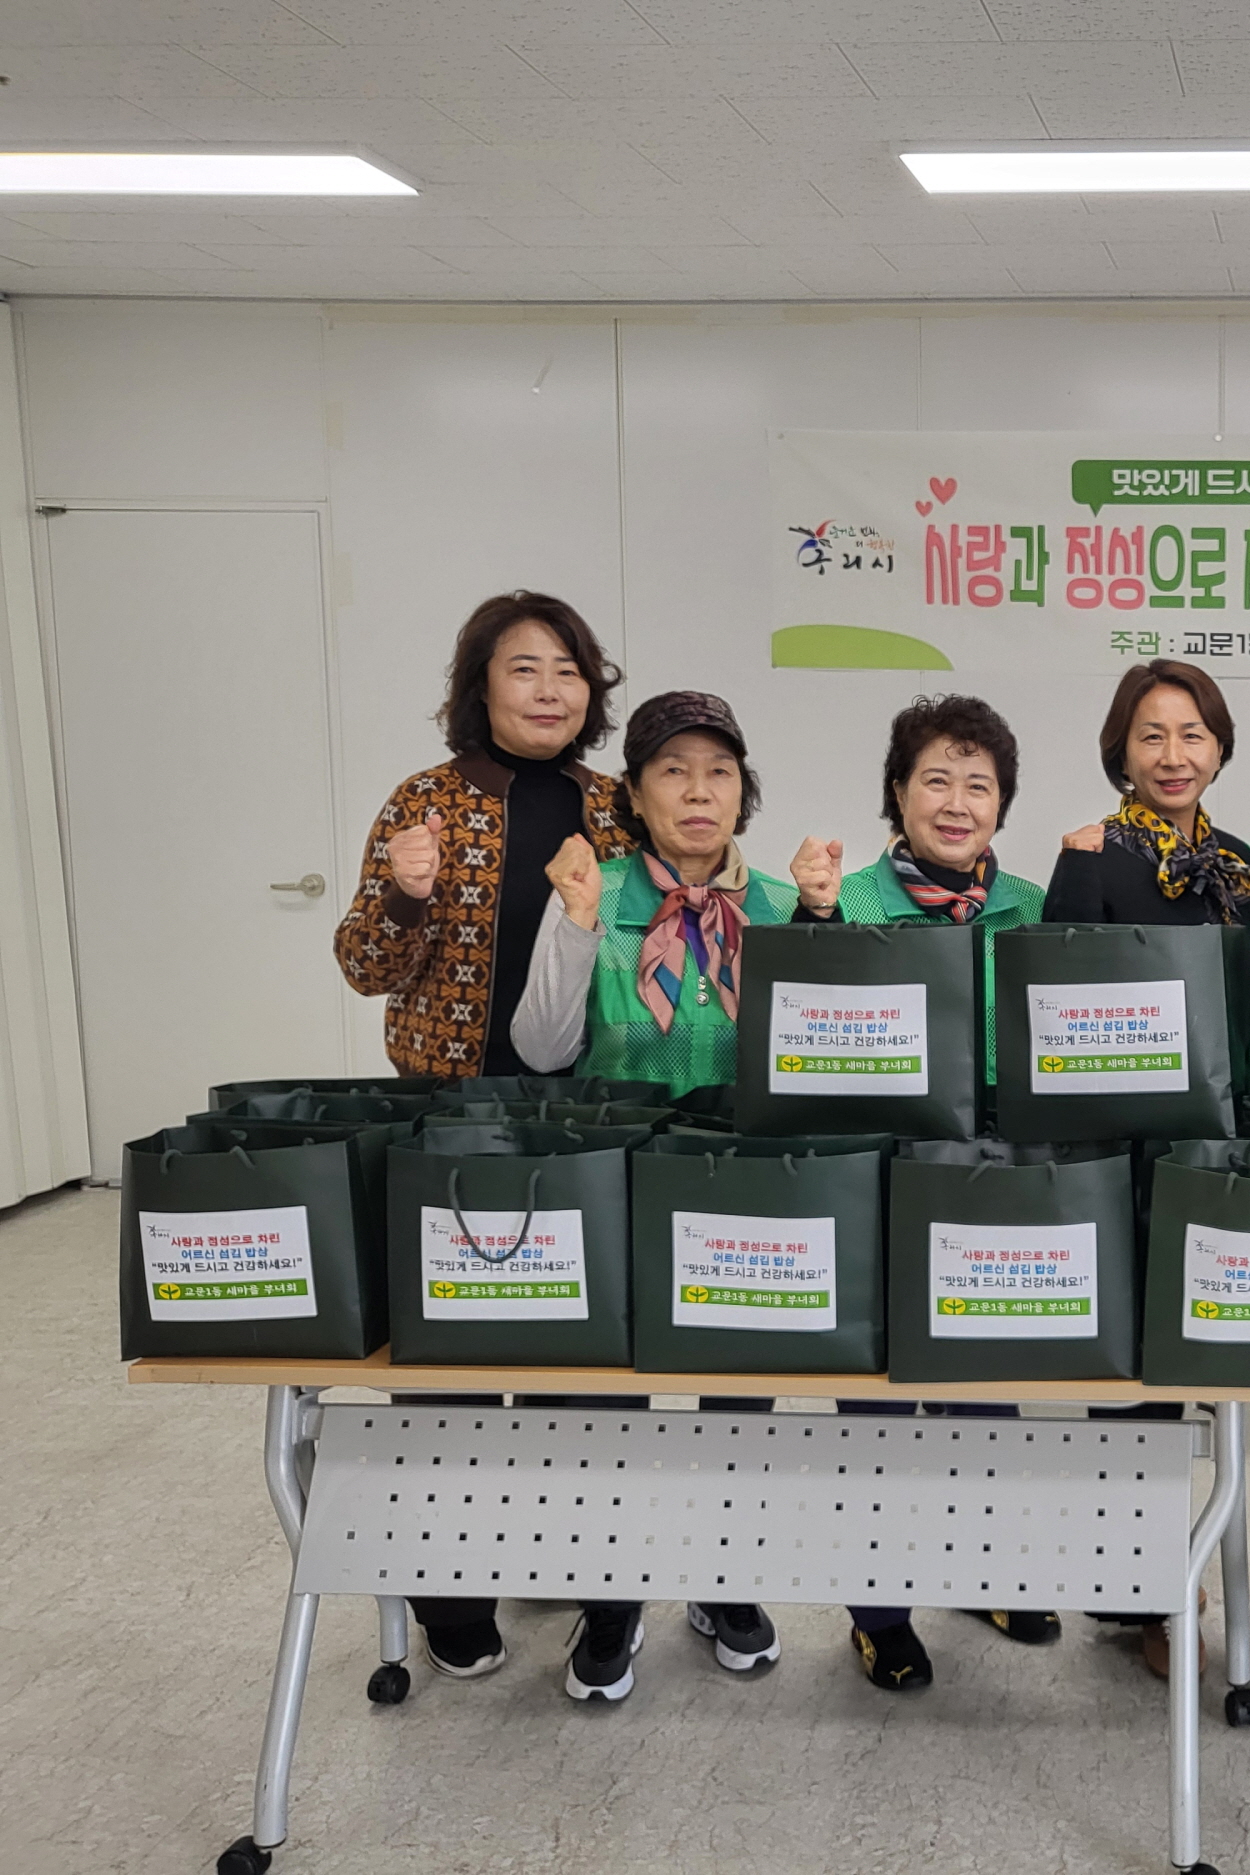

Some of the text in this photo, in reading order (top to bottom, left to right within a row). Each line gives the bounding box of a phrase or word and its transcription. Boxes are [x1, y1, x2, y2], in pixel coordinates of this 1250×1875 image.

[1112, 469, 1200, 497] 맛있게
[801, 548, 894, 576] 구리시
[925, 523, 1050, 608] 사랑과
[1065, 524, 1227, 610] 정성으로
[1110, 631, 1161, 656] 주관
[800, 1009, 900, 1020] 사랑과 정성으로 차린
[1059, 1006, 1160, 1019] 사랑과 정성으로 차린
[808, 1022, 888, 1033] 어르신 섬김 밥상
[1068, 1020, 1148, 1032] 어르신 섬김 밥상
[818, 1035, 849, 1046] 드시고
[1079, 1034, 1110, 1044] 드시고
[846, 1060, 876, 1071] 새마을
[1107, 1058, 1137, 1068] 새마을
[705, 1239, 808, 1253] 사랑과 정성으로 차린
[714, 1253, 795, 1266] 어르신 섬김 밥상
[963, 1250, 1070, 1261] 사랑과 정성으로 차린
[1216, 1255, 1249, 1267] 사랑과
[724, 1267, 756, 1277] 드시고
[972, 1264, 1057, 1274] 어르신 섬김 밥상
[983, 1277, 1016, 1287] 드시고
[752, 1292, 783, 1304] 새마을
[1011, 1302, 1043, 1312] 새마을
